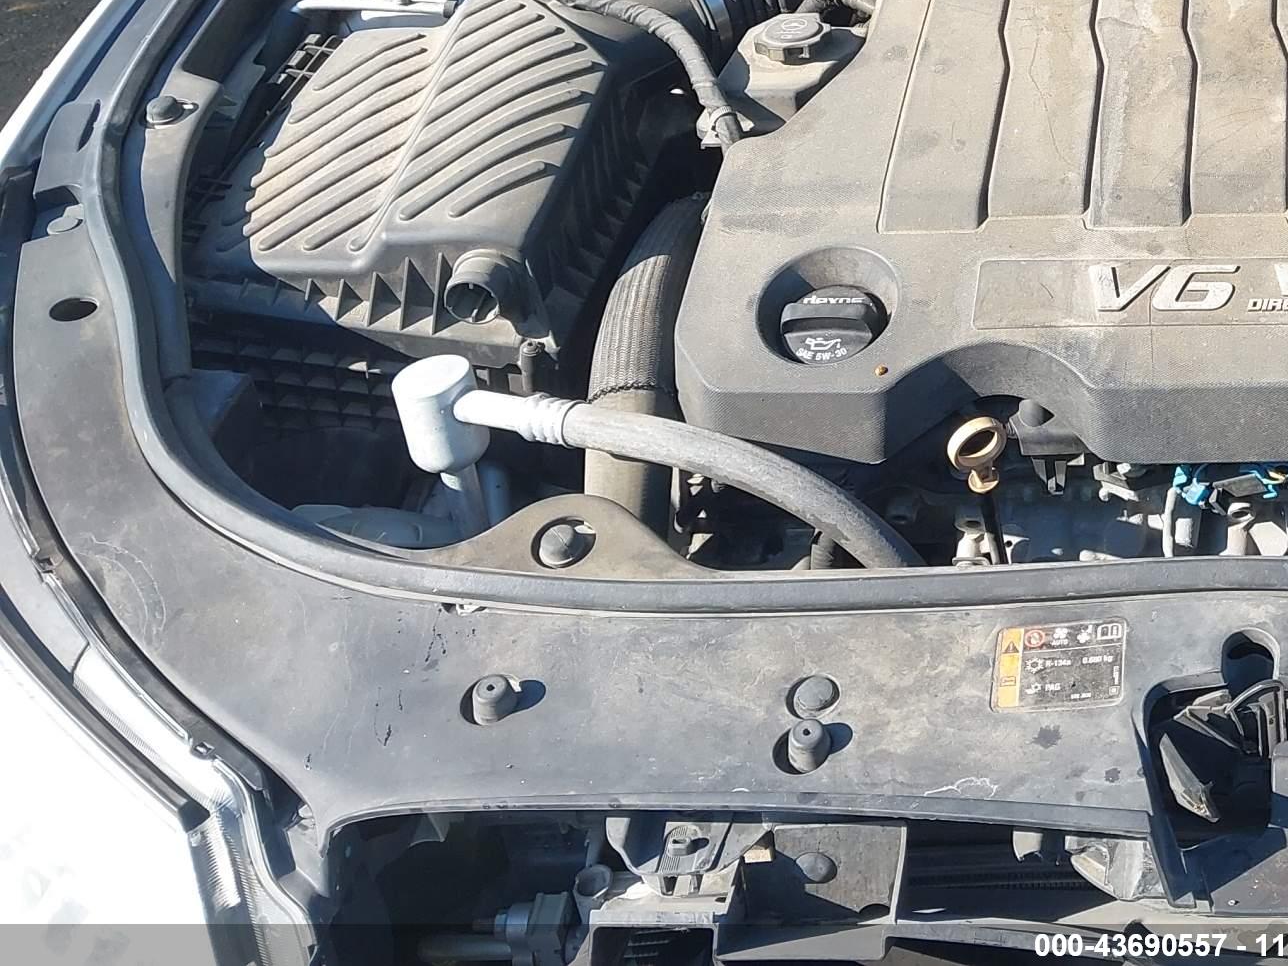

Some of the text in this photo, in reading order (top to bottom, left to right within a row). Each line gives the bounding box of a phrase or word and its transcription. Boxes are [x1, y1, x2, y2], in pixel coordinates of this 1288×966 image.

[1088, 264, 1240, 312] V6
[796, 347, 847, 360] SAE 5W-30
